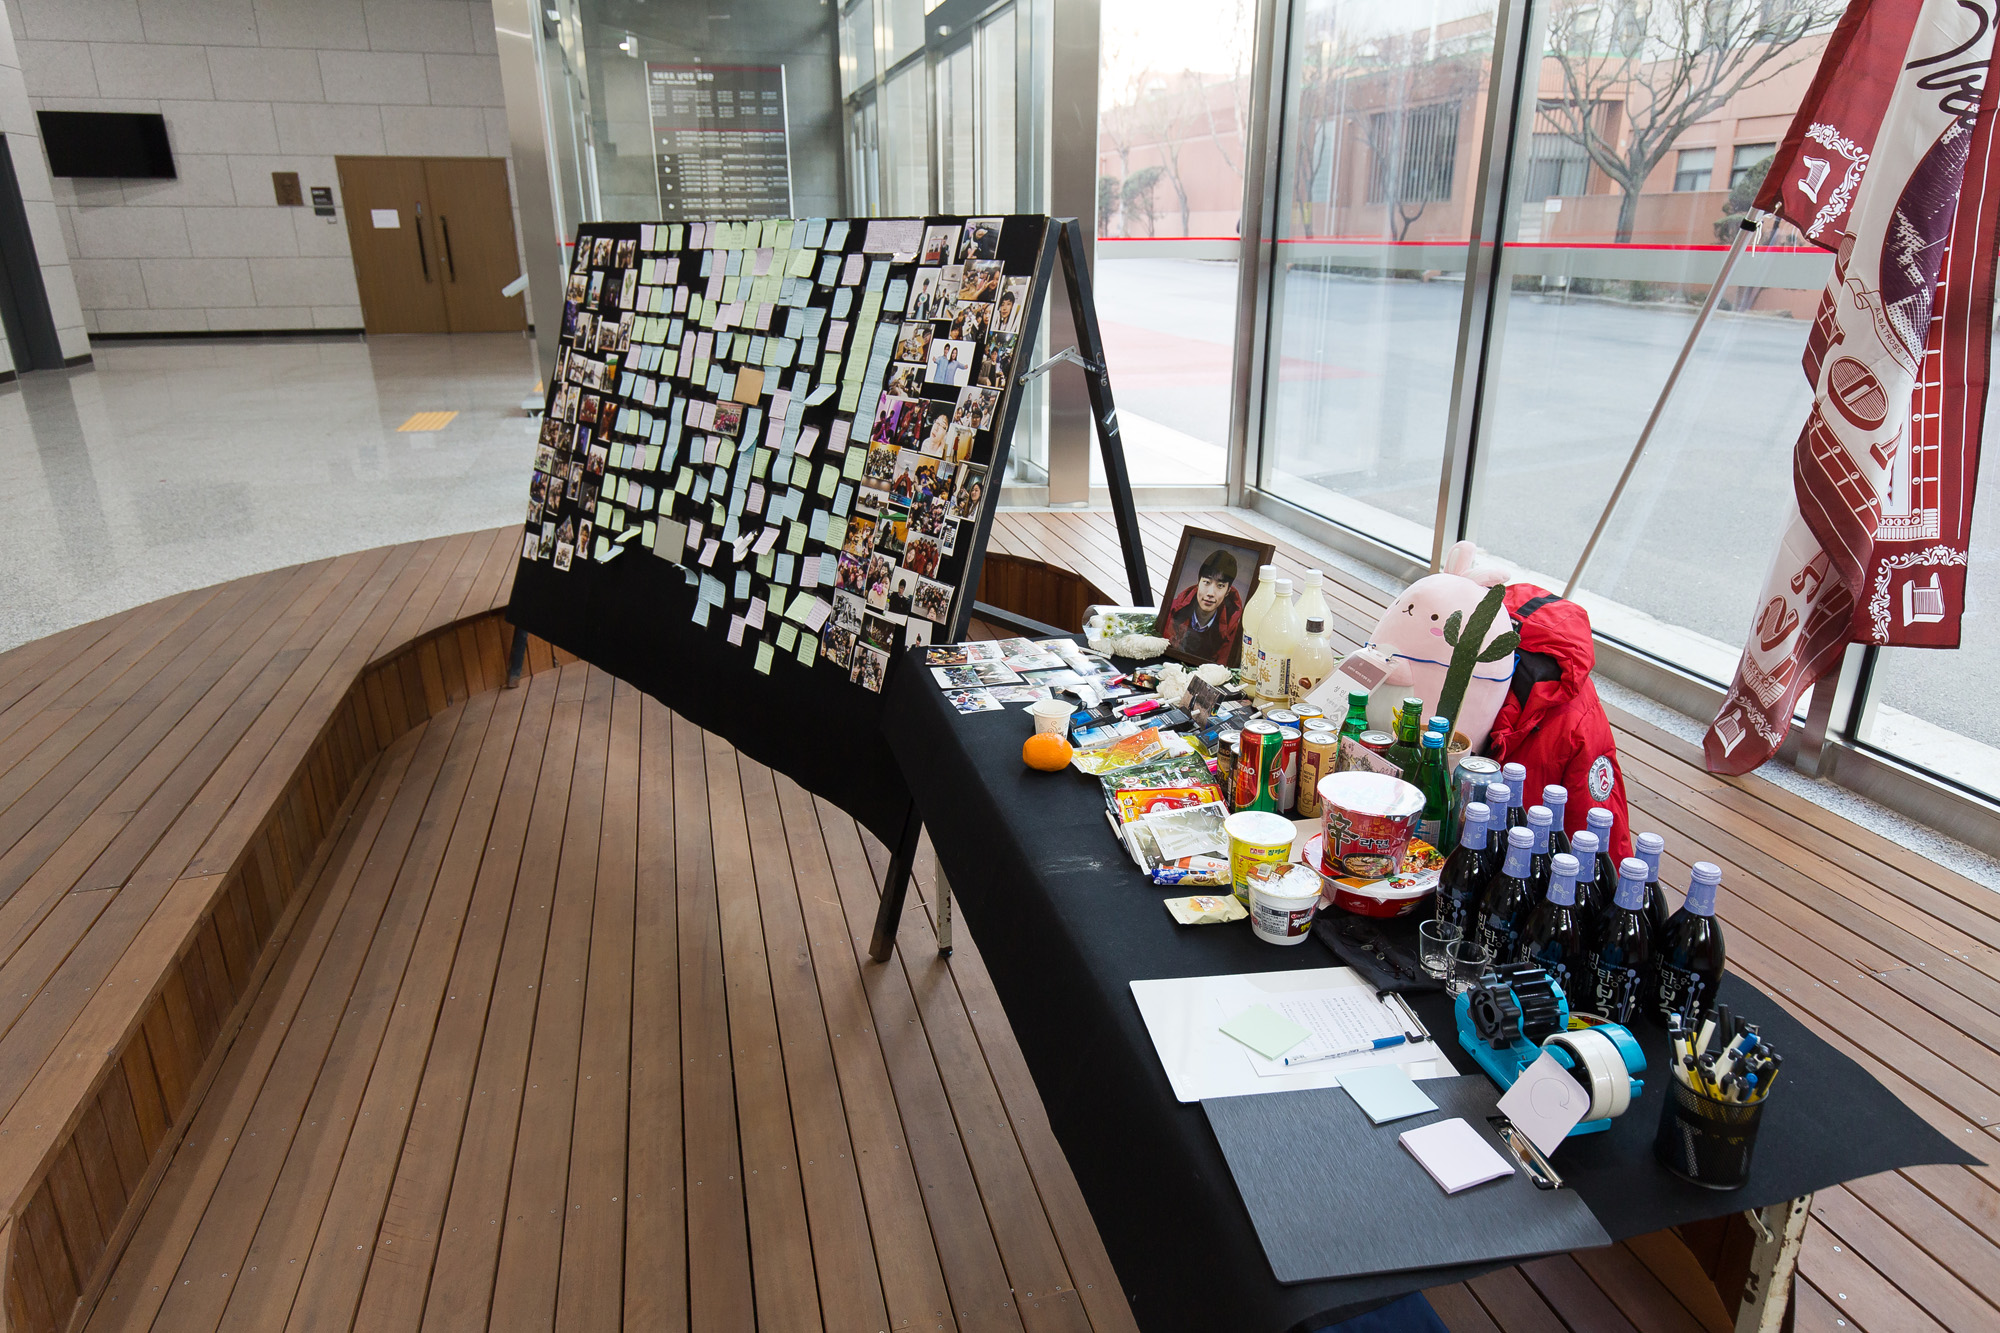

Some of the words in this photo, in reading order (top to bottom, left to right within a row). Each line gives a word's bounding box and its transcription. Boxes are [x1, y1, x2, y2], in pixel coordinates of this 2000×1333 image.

[1874, 307, 1903, 355] ALBATROSS
[1902, 354, 1919, 375] TOWE
[1327, 812, 1360, 857] 辛
[1359, 838, 1390, 849] 라면
